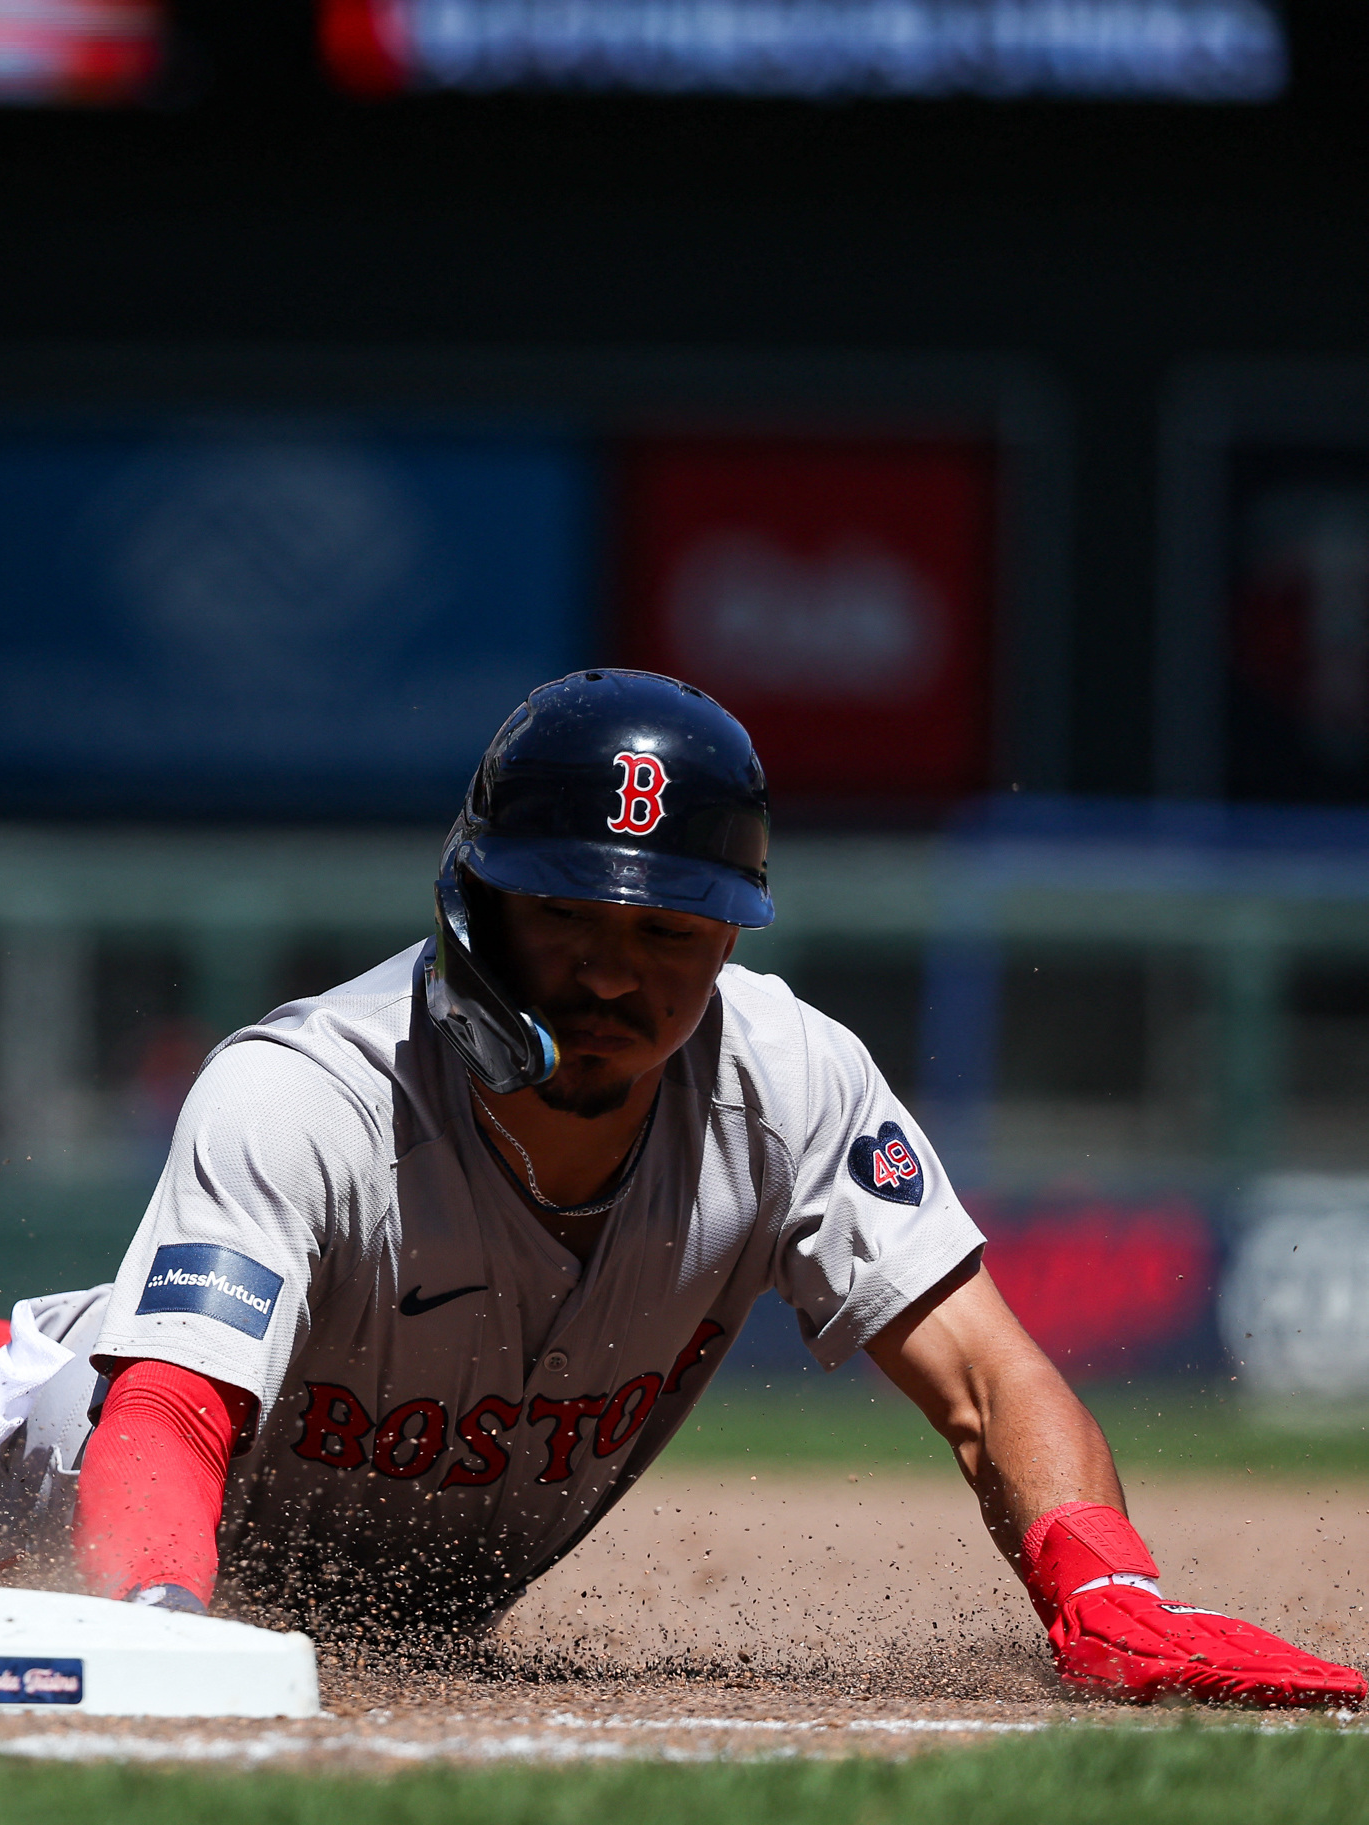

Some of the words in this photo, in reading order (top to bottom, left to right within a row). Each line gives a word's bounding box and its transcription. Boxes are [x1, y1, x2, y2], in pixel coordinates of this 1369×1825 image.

[606, 751, 670, 836] B
[873, 1139, 918, 1188] 49
[163, 1268, 271, 1315] MassMutual
[22, 1667, 79, 1694] Twins
